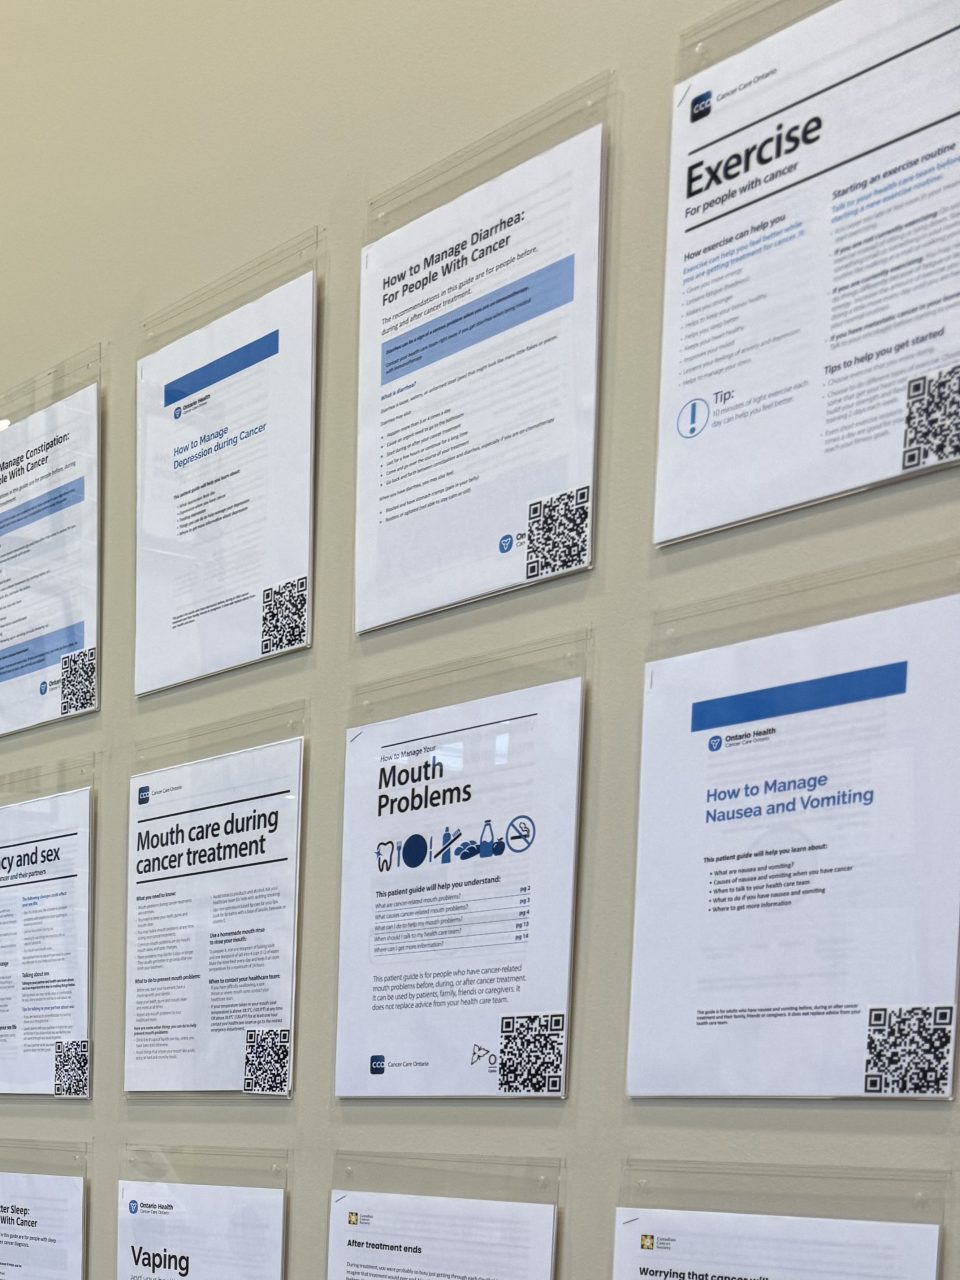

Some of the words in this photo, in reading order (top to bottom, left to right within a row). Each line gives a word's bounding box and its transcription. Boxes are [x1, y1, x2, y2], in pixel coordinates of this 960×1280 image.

[686, 115, 822, 199] Exercise
[685, 205, 700, 218] For
[703, 188, 736, 213] people
[740, 178, 761, 194] with
[763, 162, 798, 183] cancer
[383, 272, 406, 290] How
[409, 264, 420, 276] to
[423, 240, 467, 267] Manage
[471, 211, 525, 245] Diarrhea:
[684, 248, 701, 262] How
[702, 237, 733, 254] exercise
[734, 229, 749, 239] can
[750, 221, 768, 236] help
[770, 214, 786, 228] you
[383, 291, 398, 306] For
[402, 271, 437, 297] People
[441, 254, 467, 277] With
[471, 235, 511, 262] Cancer
[714, 389, 734, 405] Tip:
[0, 453, 24, 474] Manage
[26, 433, 70, 460] Constipation:
[174, 443, 189, 457] How
[191, 439, 197, 449] to
[200, 426, 228, 446] Manage
[174, 447, 212, 469] Depression
[214, 436, 238, 454] during
[239, 423, 266, 441] Cancer
[9, 466, 25, 480] With
[27, 455, 49, 473] Cancer
[726, 731, 751, 742] Ontario
[753, 728, 776, 737] Health
[379, 756, 443, 789] Mouth
[707, 788, 739, 802] How
[745, 785, 759, 797] to
[764, 774, 827, 795] Manage
[378, 784, 472, 816] Problems
[706, 805, 761, 822] Nausea
[767, 800, 795, 814] and
[800, 788, 874, 809] Vomiting
[137, 824, 184, 851] Mouth
[188, 822, 220, 841] care
[224, 809, 278, 835] during
[16, 851, 38, 867] and
[40, 847, 60, 862] sex
[137, 852, 183, 874] cancer
[187, 835, 266, 866] treatment
[388, 888, 408, 898] patient
[409, 885, 425, 895] guide
[437, 882, 451, 891] help
[452, 882, 462, 890] you
[464, 877, 501, 887] understand:
[1, 1216, 15, 1226] With
[16, 1217, 37, 1228] Cancer
[11, 1206, 30, 1216] Sleep:
[131, 1246, 189, 1277] Vaping
[347, 1240, 365, 1249] After
[366, 1241, 402, 1252] treatment
[404, 1245, 422, 1254] ends
